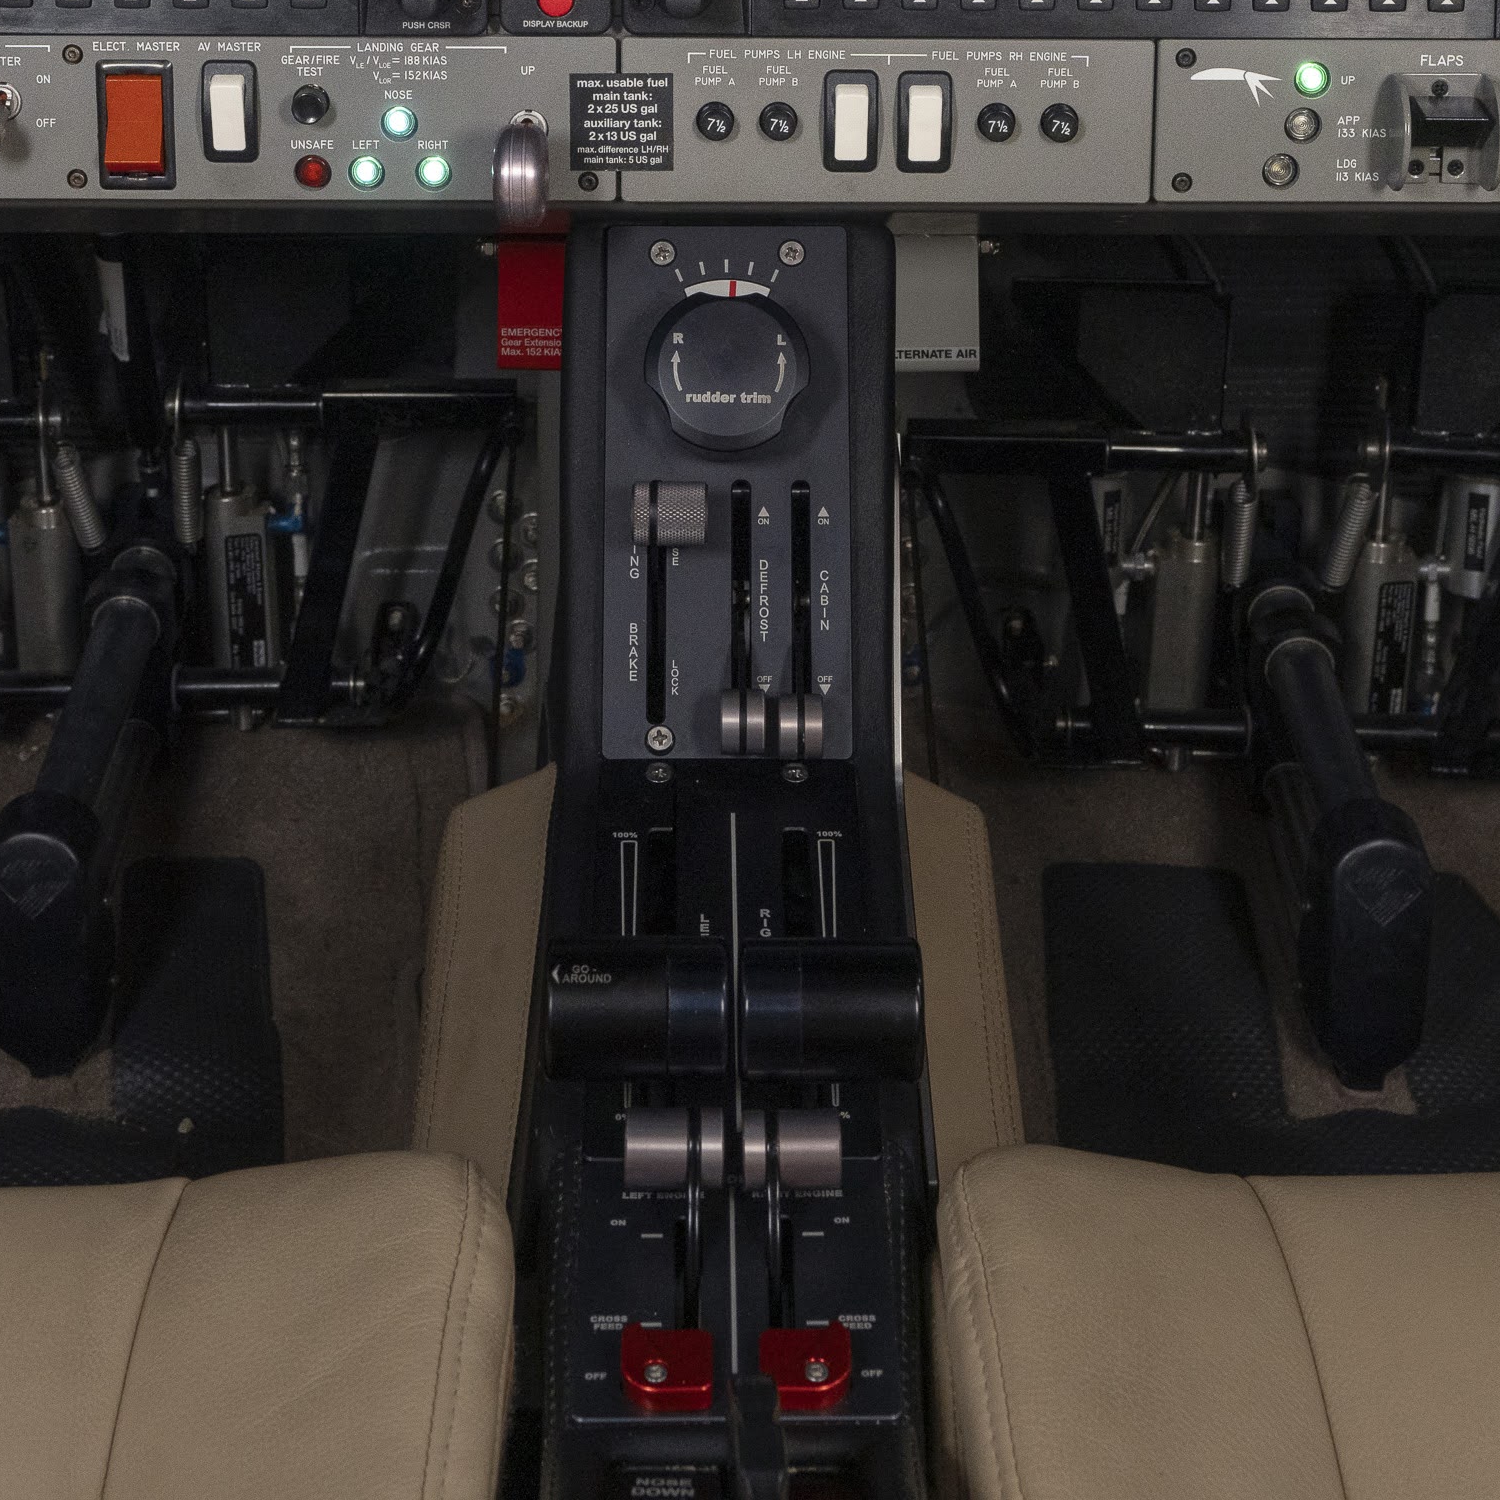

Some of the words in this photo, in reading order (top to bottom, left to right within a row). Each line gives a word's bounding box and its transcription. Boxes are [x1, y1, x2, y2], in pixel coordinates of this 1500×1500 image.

[523, 20, 554, 28] DISPLAY
[557, 20, 588, 28] BACKUP
[357, 42, 403, 52] LANDING
[410, 43, 439, 52] GEAR
[709, 50, 737, 59] FUEL
[744, 50, 781, 59] PUMPS
[787, 50, 801, 59] LH
[808, 50, 845, 59] ENGINE
[1420, 55, 1463, 67] FLAPS
[577, 80, 603, 88] max.
[606, 78, 643, 88] usable
[647, 78, 668, 88] fuel
[1341, 76, 1355, 85] UP
[384, 90, 413, 100] NOSE
[291, 140, 333, 149] UNSAFE
[686, 392, 736, 403] rudder
[740, 392, 771, 404] trim
[562, 974, 611, 983] AROUND
